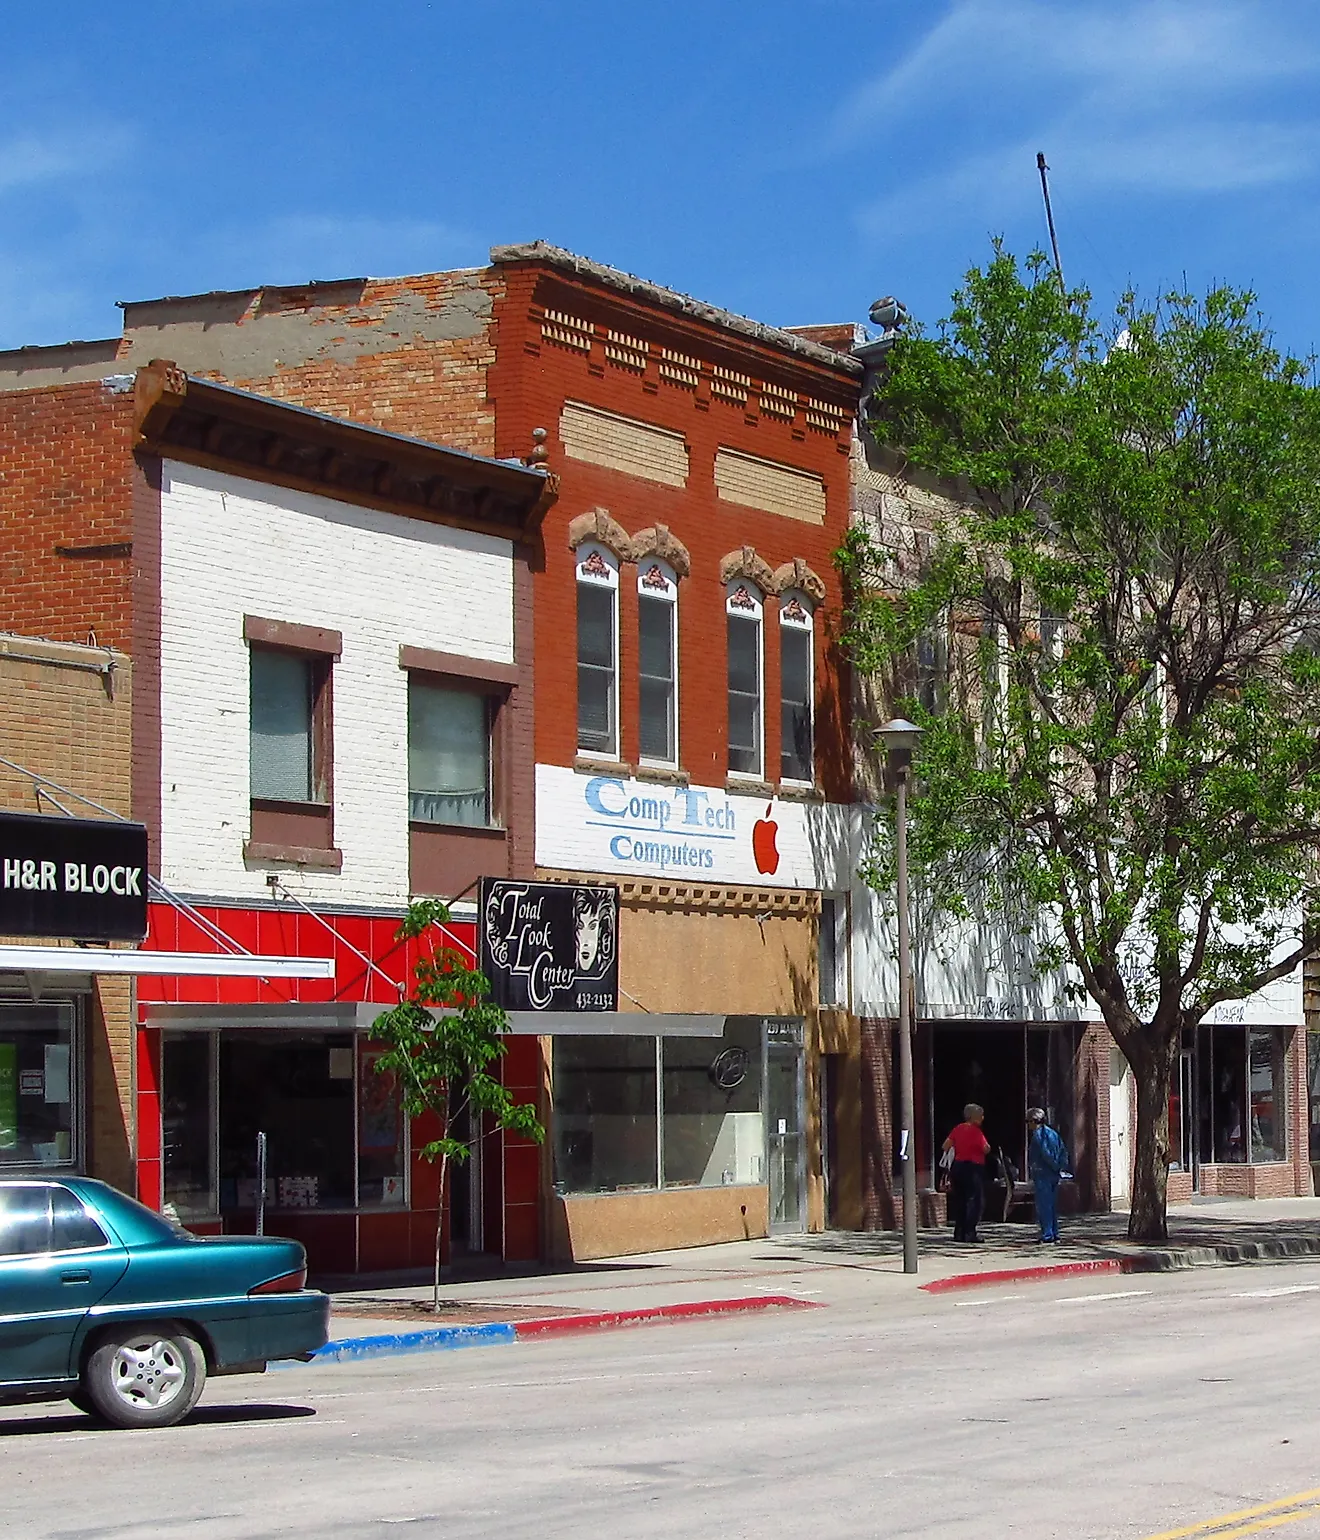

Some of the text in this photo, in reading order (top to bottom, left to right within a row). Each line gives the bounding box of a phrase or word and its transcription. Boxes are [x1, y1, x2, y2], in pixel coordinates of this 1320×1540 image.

[585, 777, 735, 831] Comp Tech
[4, 858, 142, 896] H&R BLOCK
[610, 835, 713, 870] Computers
[501, 890, 544, 940] Total
[513, 921, 553, 971] Look
[531, 951, 575, 1004] Center
[576, 993, 613, 1009] 432-2132
